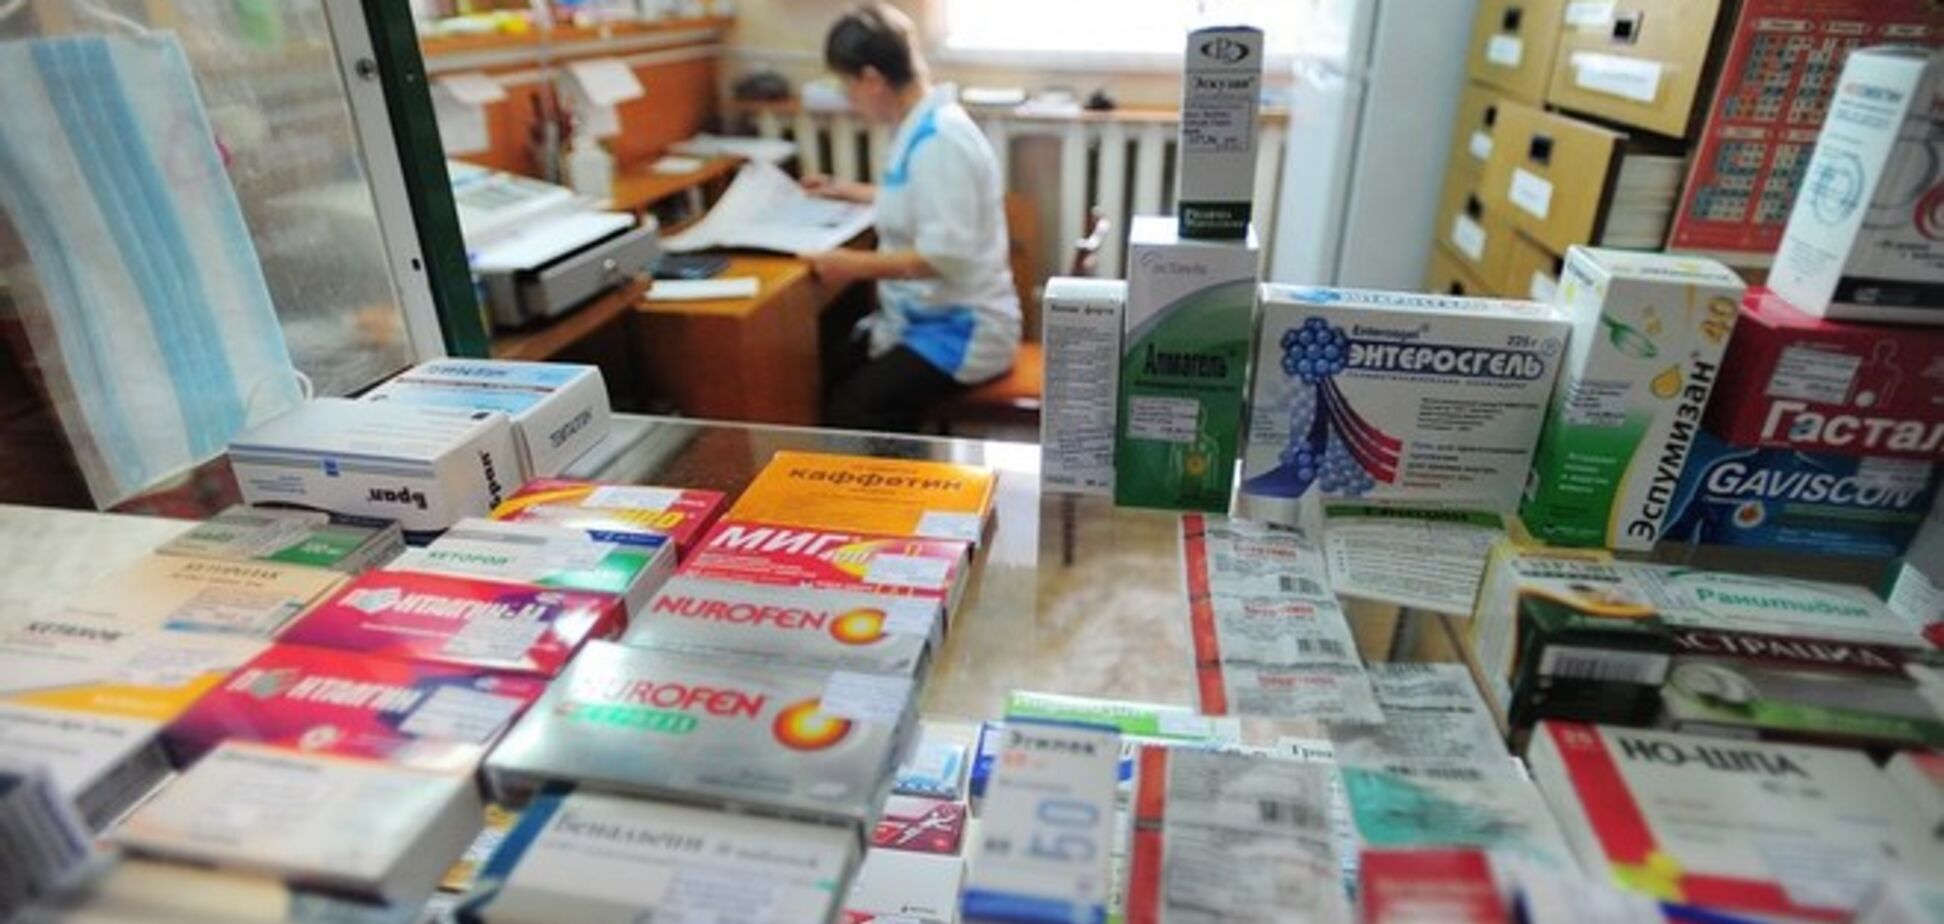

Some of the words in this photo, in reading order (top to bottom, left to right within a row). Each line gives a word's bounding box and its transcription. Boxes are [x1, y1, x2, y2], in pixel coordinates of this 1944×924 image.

[1349, 343, 1544, 379] ЭНТЕРОСГЕЛЬ
[1628, 360, 1716, 541] Эспумизан
[1706, 461, 1914, 508] GAVISCON
[651, 594, 828, 630] NUROFEN
